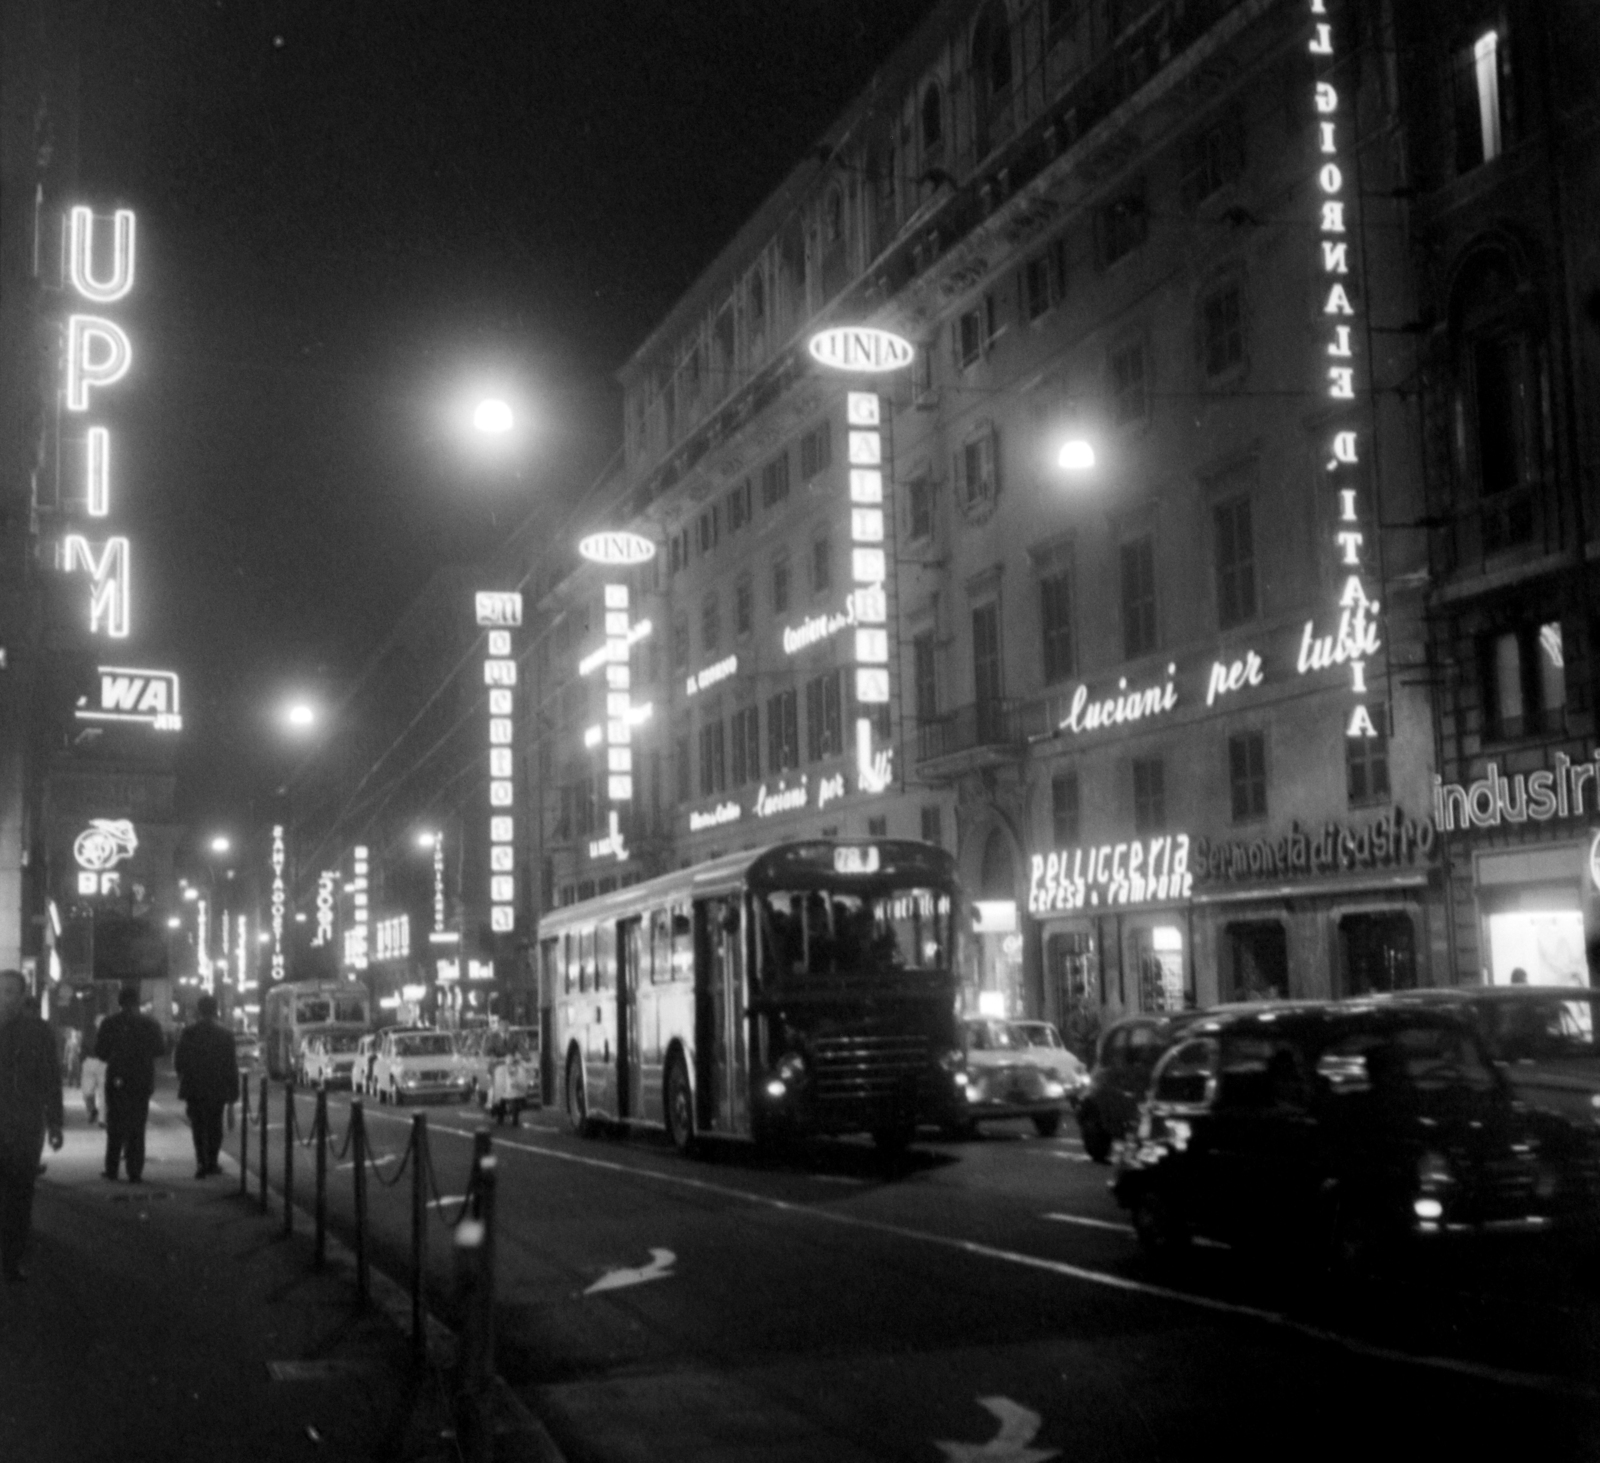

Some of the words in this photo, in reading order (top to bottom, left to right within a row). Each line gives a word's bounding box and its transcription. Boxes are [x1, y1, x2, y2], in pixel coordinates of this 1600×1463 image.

[66, 205, 136, 638] UPIM
[849, 393, 888, 702] GALLERIA
[77, 675, 167, 711] WA
[1206, 650, 1264, 707] per
